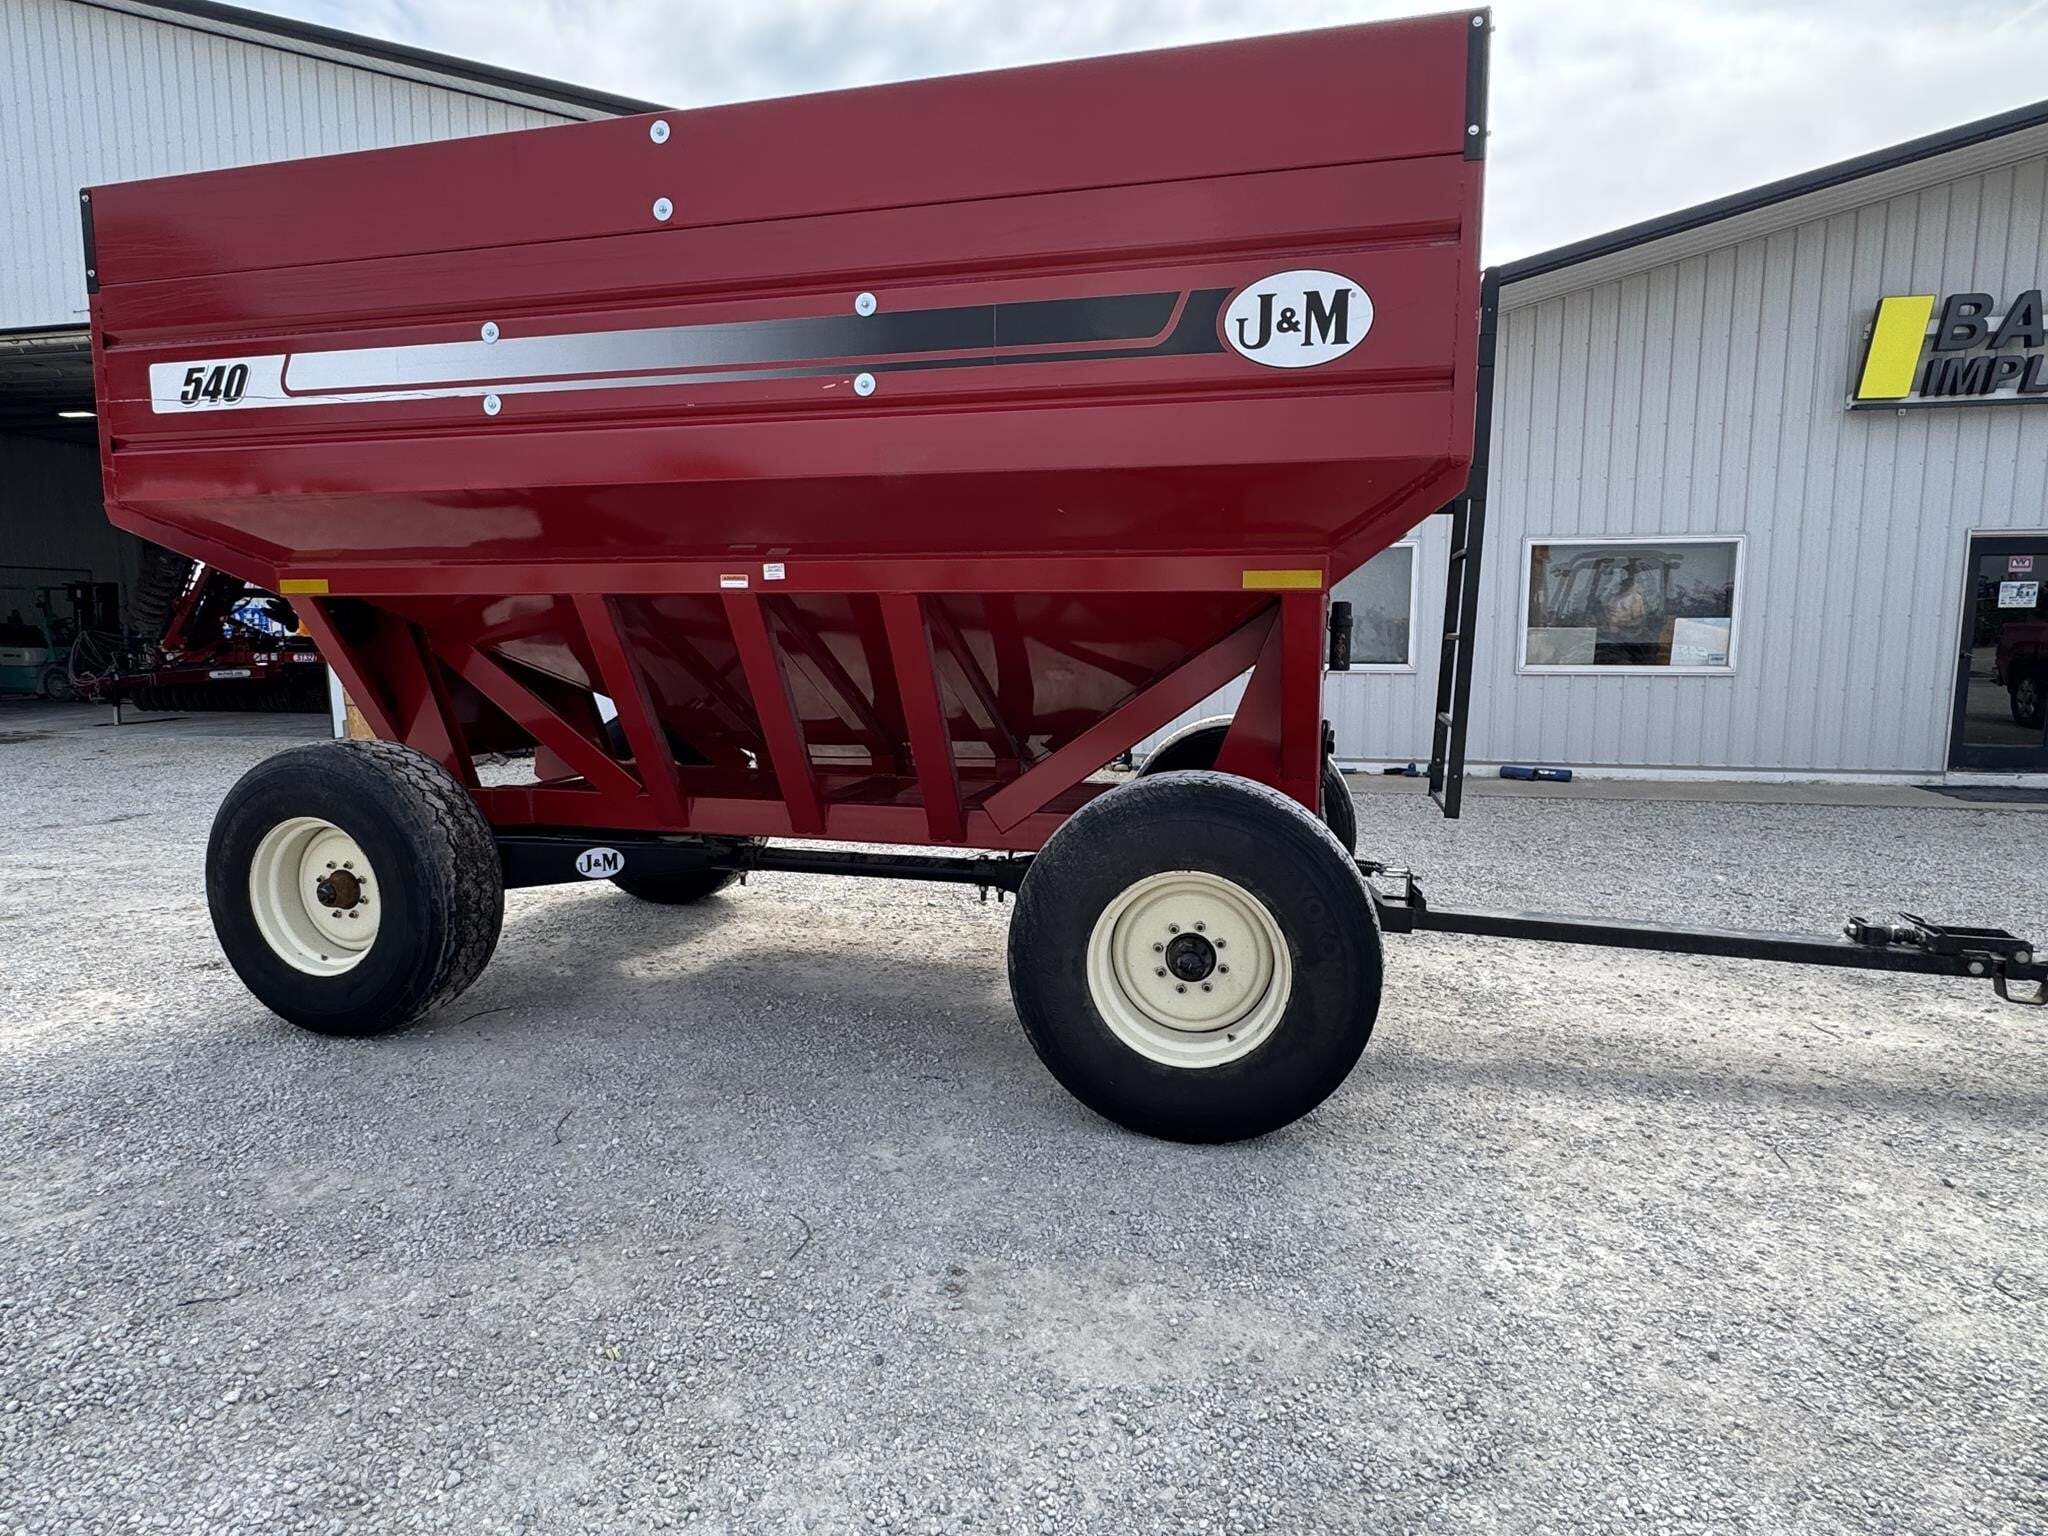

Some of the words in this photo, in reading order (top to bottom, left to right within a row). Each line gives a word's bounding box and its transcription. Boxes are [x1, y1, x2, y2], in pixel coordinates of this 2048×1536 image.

[1236, 288, 1352, 350] J&M
[1932, 290, 2044, 352] BA
[180, 364, 249, 405] 540
[1919, 354, 2048, 398] IMPL
[579, 853, 618, 873] J&M
